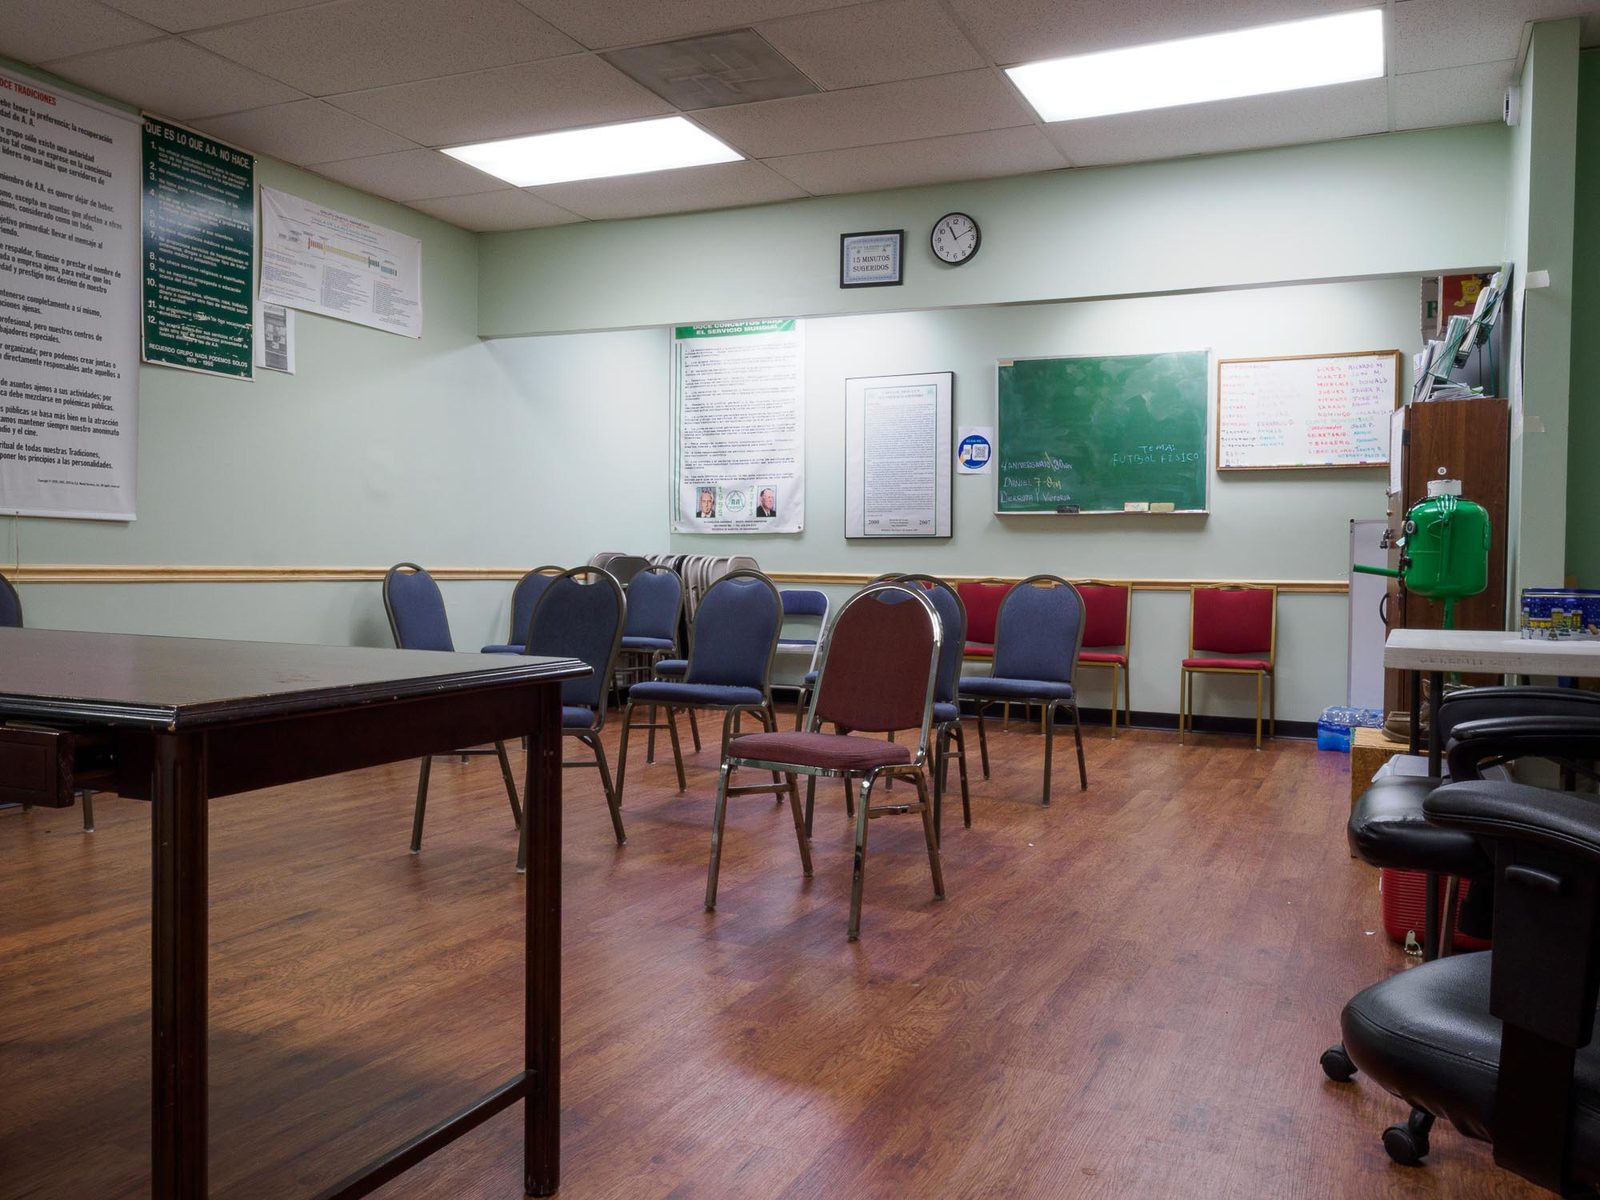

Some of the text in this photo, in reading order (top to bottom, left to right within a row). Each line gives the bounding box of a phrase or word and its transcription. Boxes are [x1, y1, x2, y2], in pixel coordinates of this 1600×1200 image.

[15, 82, 56, 107] TRADICIONES
[145, 123, 161, 136] QUE
[164, 128, 174, 140] ES
[177, 133, 186, 145] LO
[188, 138, 202, 151] QUE
[205, 144, 218, 156] A.A.
[220, 150, 230, 161] NO
[151, 142, 156, 150] 1.
[150, 162, 156, 170] 2.
[853, 264, 889, 272] SUGERIDOS
[147, 278, 156, 286] 10.
[149, 343, 175, 353] RECUERDO
[177, 348, 193, 357] GRUPO
[209, 356, 230, 364] PODEMOS
[233, 359, 247, 367] SOLOS
[39, 408, 52, 418] basa
[67, 412, 78, 422] bien
[88, 415, 92, 424] la
[18, 417, 119, 437] mantener siempre nuestro anonimato
[16, 442, 23, 450] de
[25, 443, 41, 452] todas
[43, 446, 67, 455] nuestras
[18, 452, 26, 460] los
[28, 453, 55, 464] principios
[62, 456, 70, 465] las
[1113, 453, 1156, 465] FUTBOL
